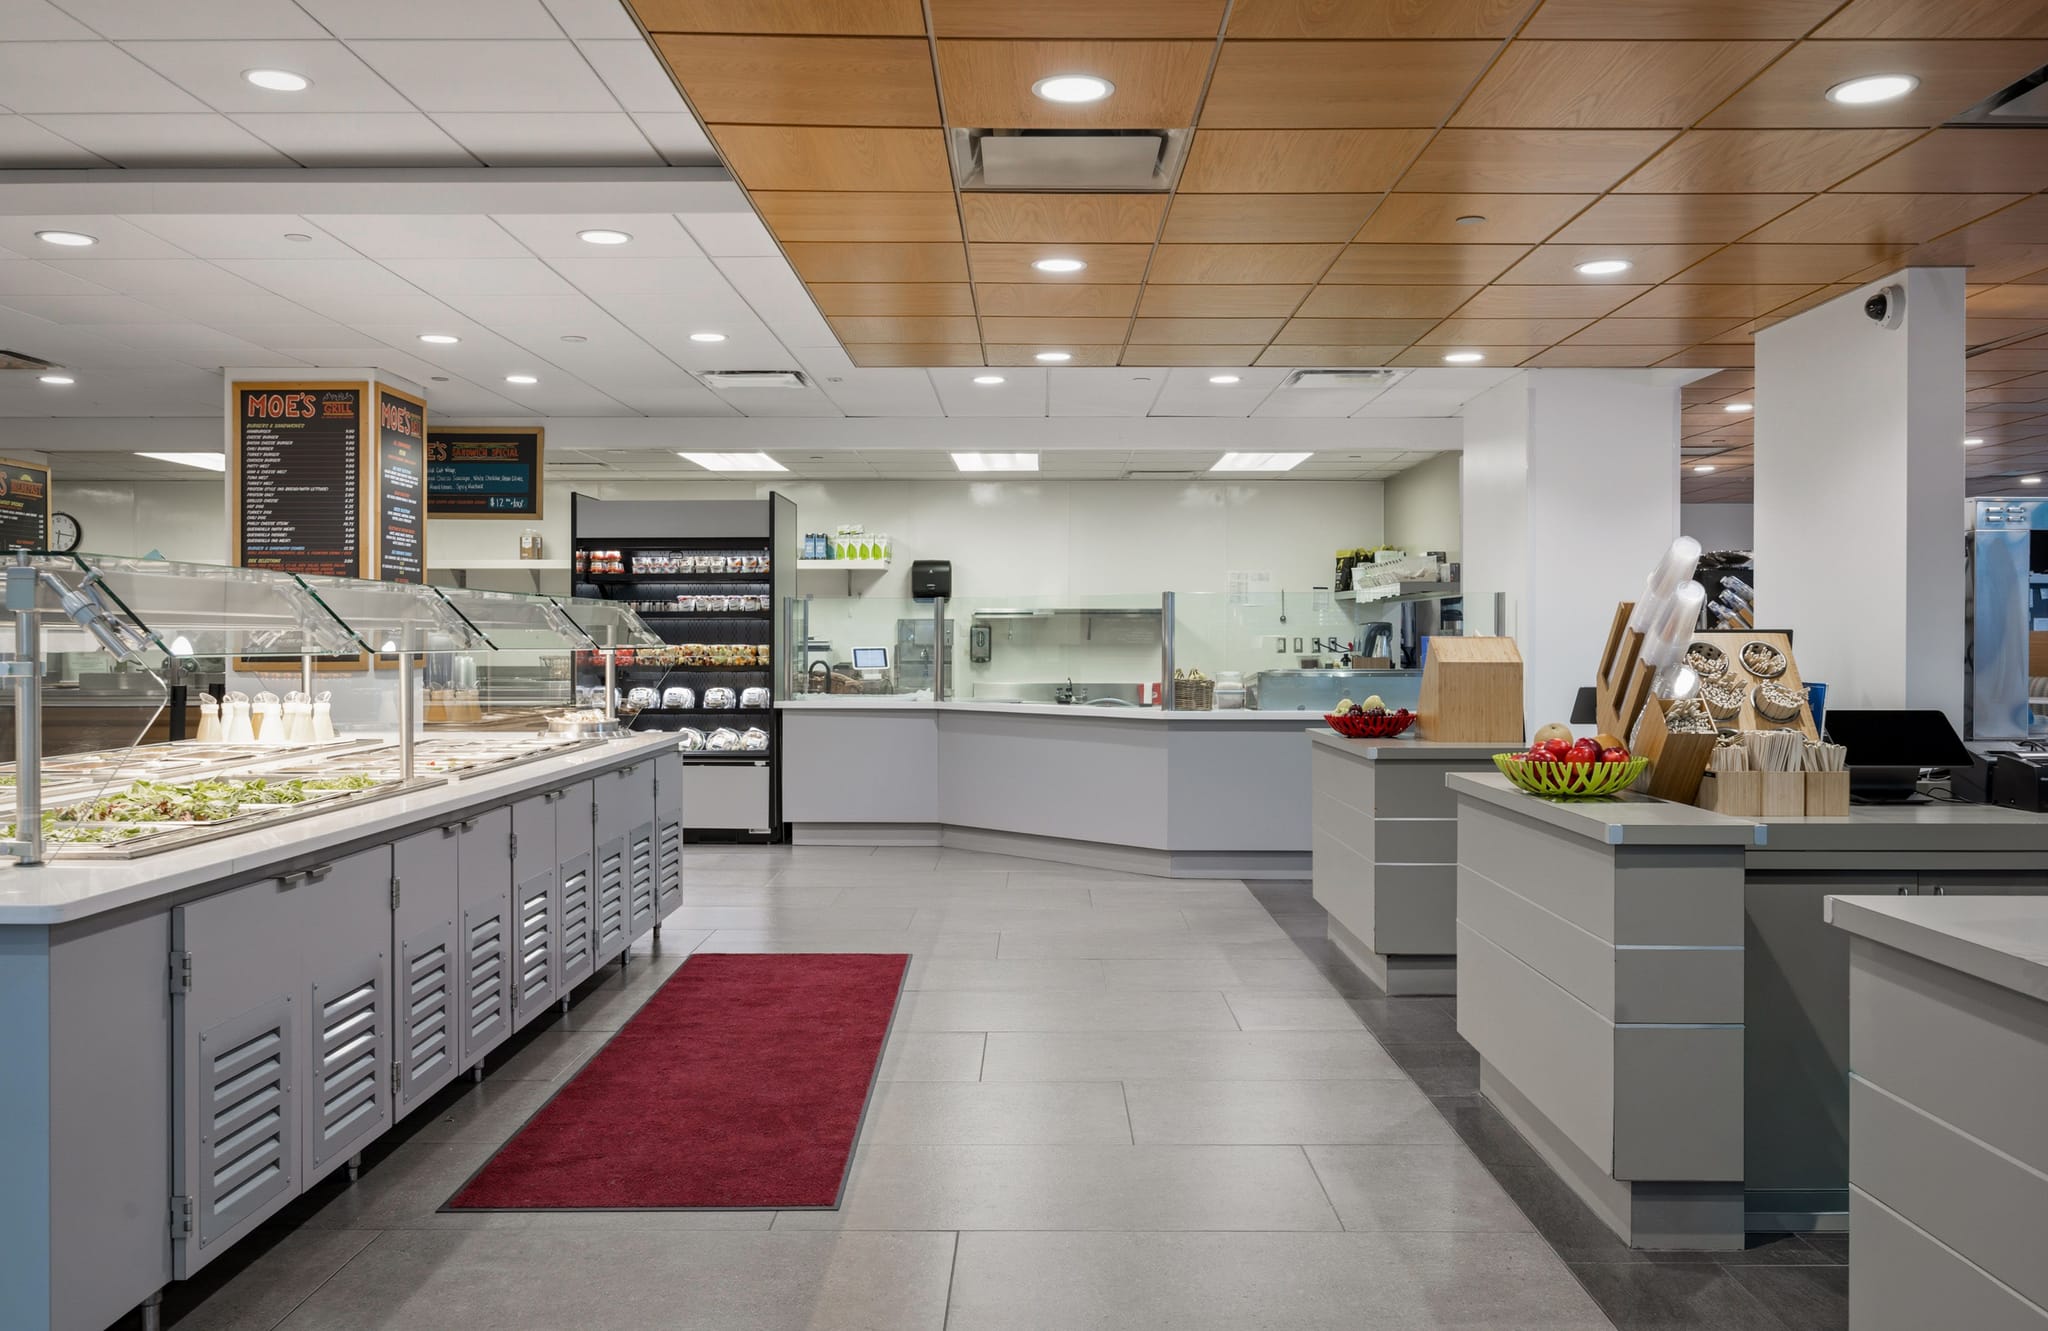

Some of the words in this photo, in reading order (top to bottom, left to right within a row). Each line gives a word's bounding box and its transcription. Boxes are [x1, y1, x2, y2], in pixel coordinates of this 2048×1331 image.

[247, 392, 317, 418] MOE'S
[382, 402, 410, 436] MOE'S
[428, 442, 448, 461] E'S
